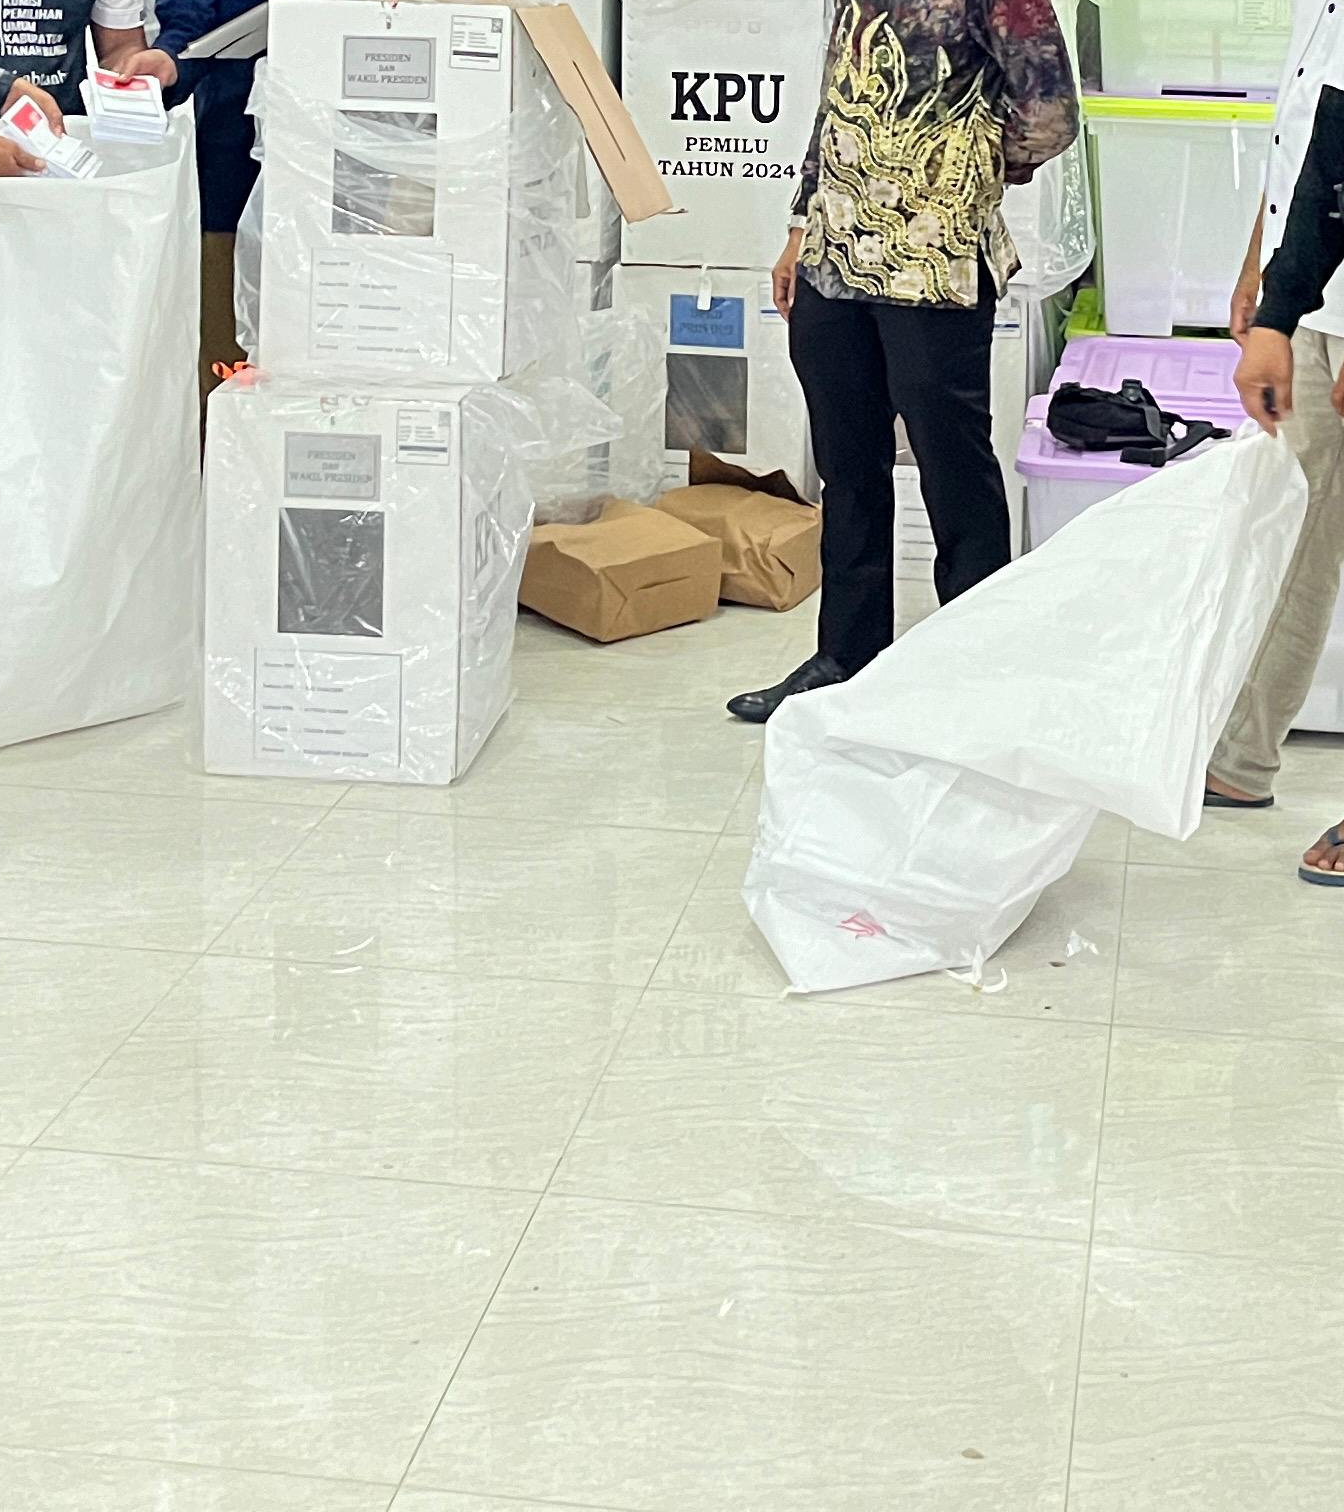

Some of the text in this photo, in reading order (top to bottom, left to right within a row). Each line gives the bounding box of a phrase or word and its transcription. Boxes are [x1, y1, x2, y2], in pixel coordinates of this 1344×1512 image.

[3, 8, 63, 20] PEMILIHAN
[3, 21, 37, 32] UMUM
[364, 53, 411, 62] PRESIDEN
[347, 74, 427, 85] WAKIL PRESIDEN
[671, 72, 785, 123] KPU
[685, 137, 768, 154] PEMILU
[658, 159, 796, 179] TAHUN 2024
